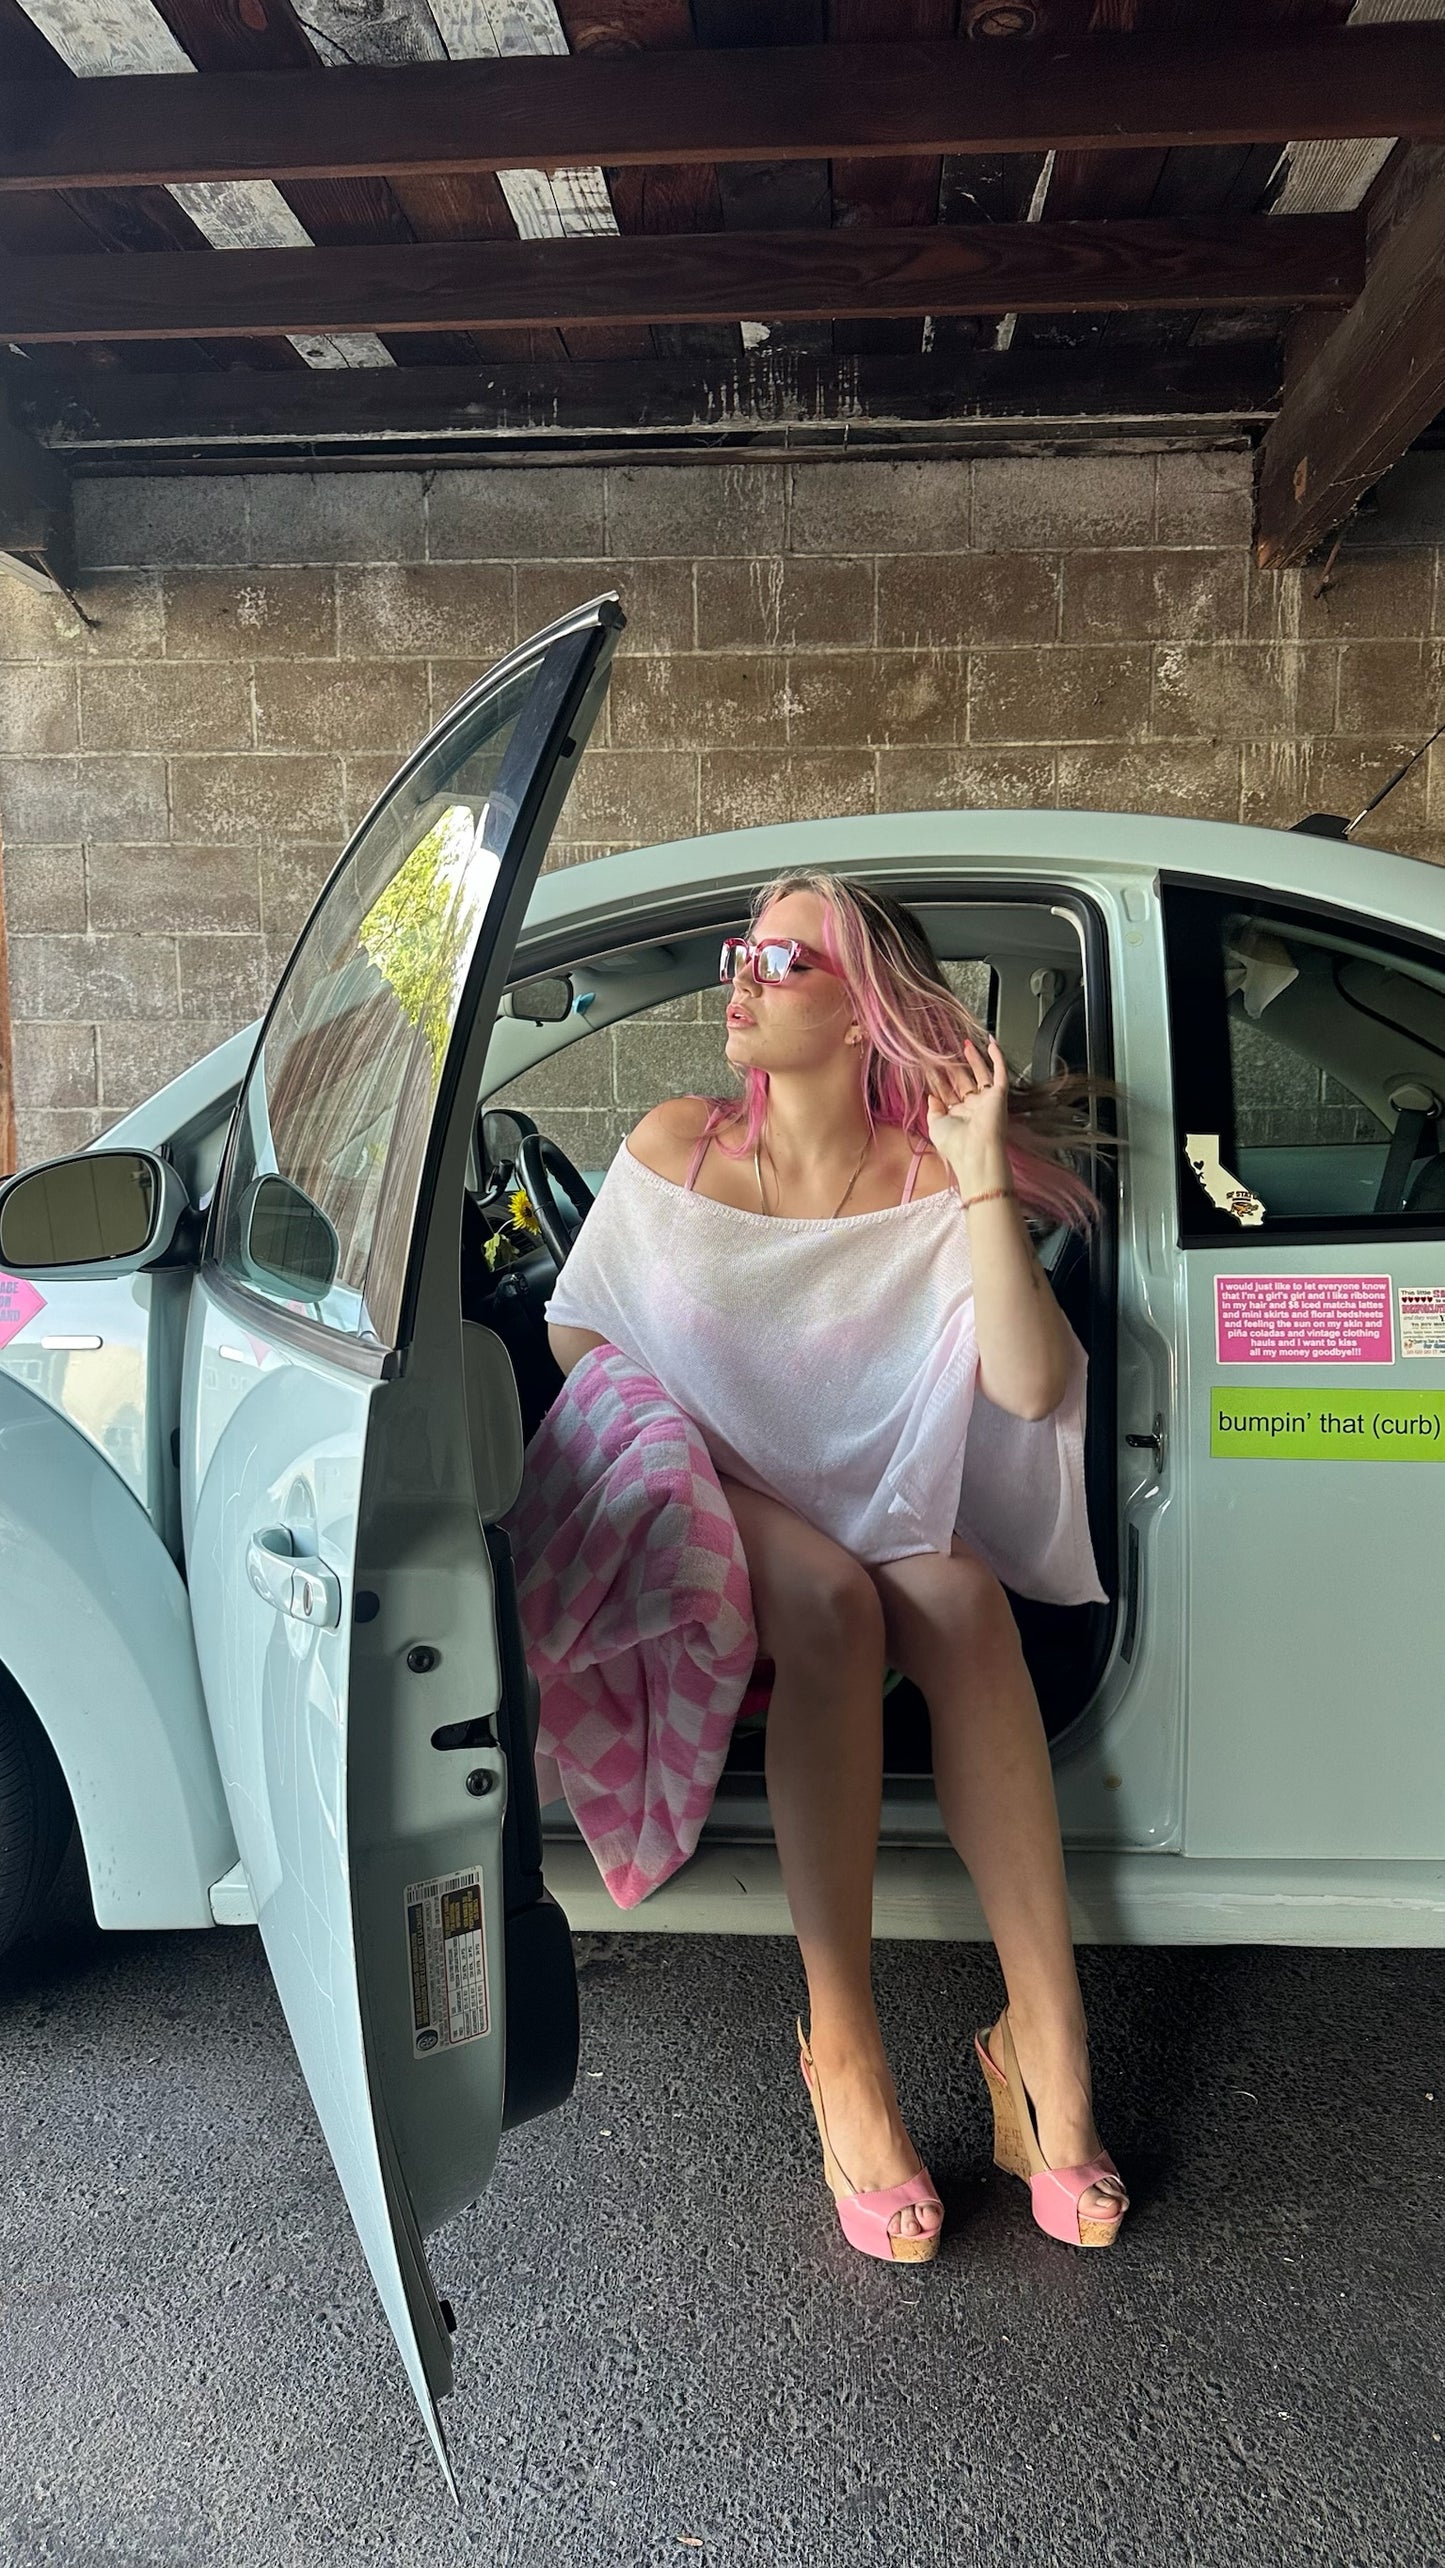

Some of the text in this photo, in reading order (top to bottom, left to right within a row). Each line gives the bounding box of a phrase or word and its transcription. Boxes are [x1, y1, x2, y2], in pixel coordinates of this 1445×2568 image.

[1225, 1282, 1253, 1290] would
[1254, 1282, 1273, 1292] just
[1274, 1282, 1291, 1290] like
[1292, 1282, 1302, 1290] to
[1304, 1282, 1316, 1290] let
[1318, 1284, 1360, 1292] everyone
[1362, 1282, 1387, 1290] know
[1222, 1292, 1240, 1300] that
[1242, 1292, 1256, 1300] I'm
[1265, 1292, 1288, 1301] girl's
[1290, 1292, 1306, 1301] girl
[1308, 1292, 1325, 1300] and
[1332, 1292, 1349, 1300] like
[1350, 1292, 1385, 1300] ribbons
[1233, 1302, 1247, 1310] my
[1243, 1320, 1275, 1329] feeling
[1327, 1321, 1341, 1329] my
[1249, 1329, 1285, 1337] coladas
[1287, 1329, 1305, 1337] and
[1306, 1329, 1340, 1338] vintage
[1342, 1329, 1380, 1339] clothing
[1249, 1348, 1361, 1358] all my money goodbye!!!
[1219, 1411, 1440, 1440] bumpin' that (curb)
